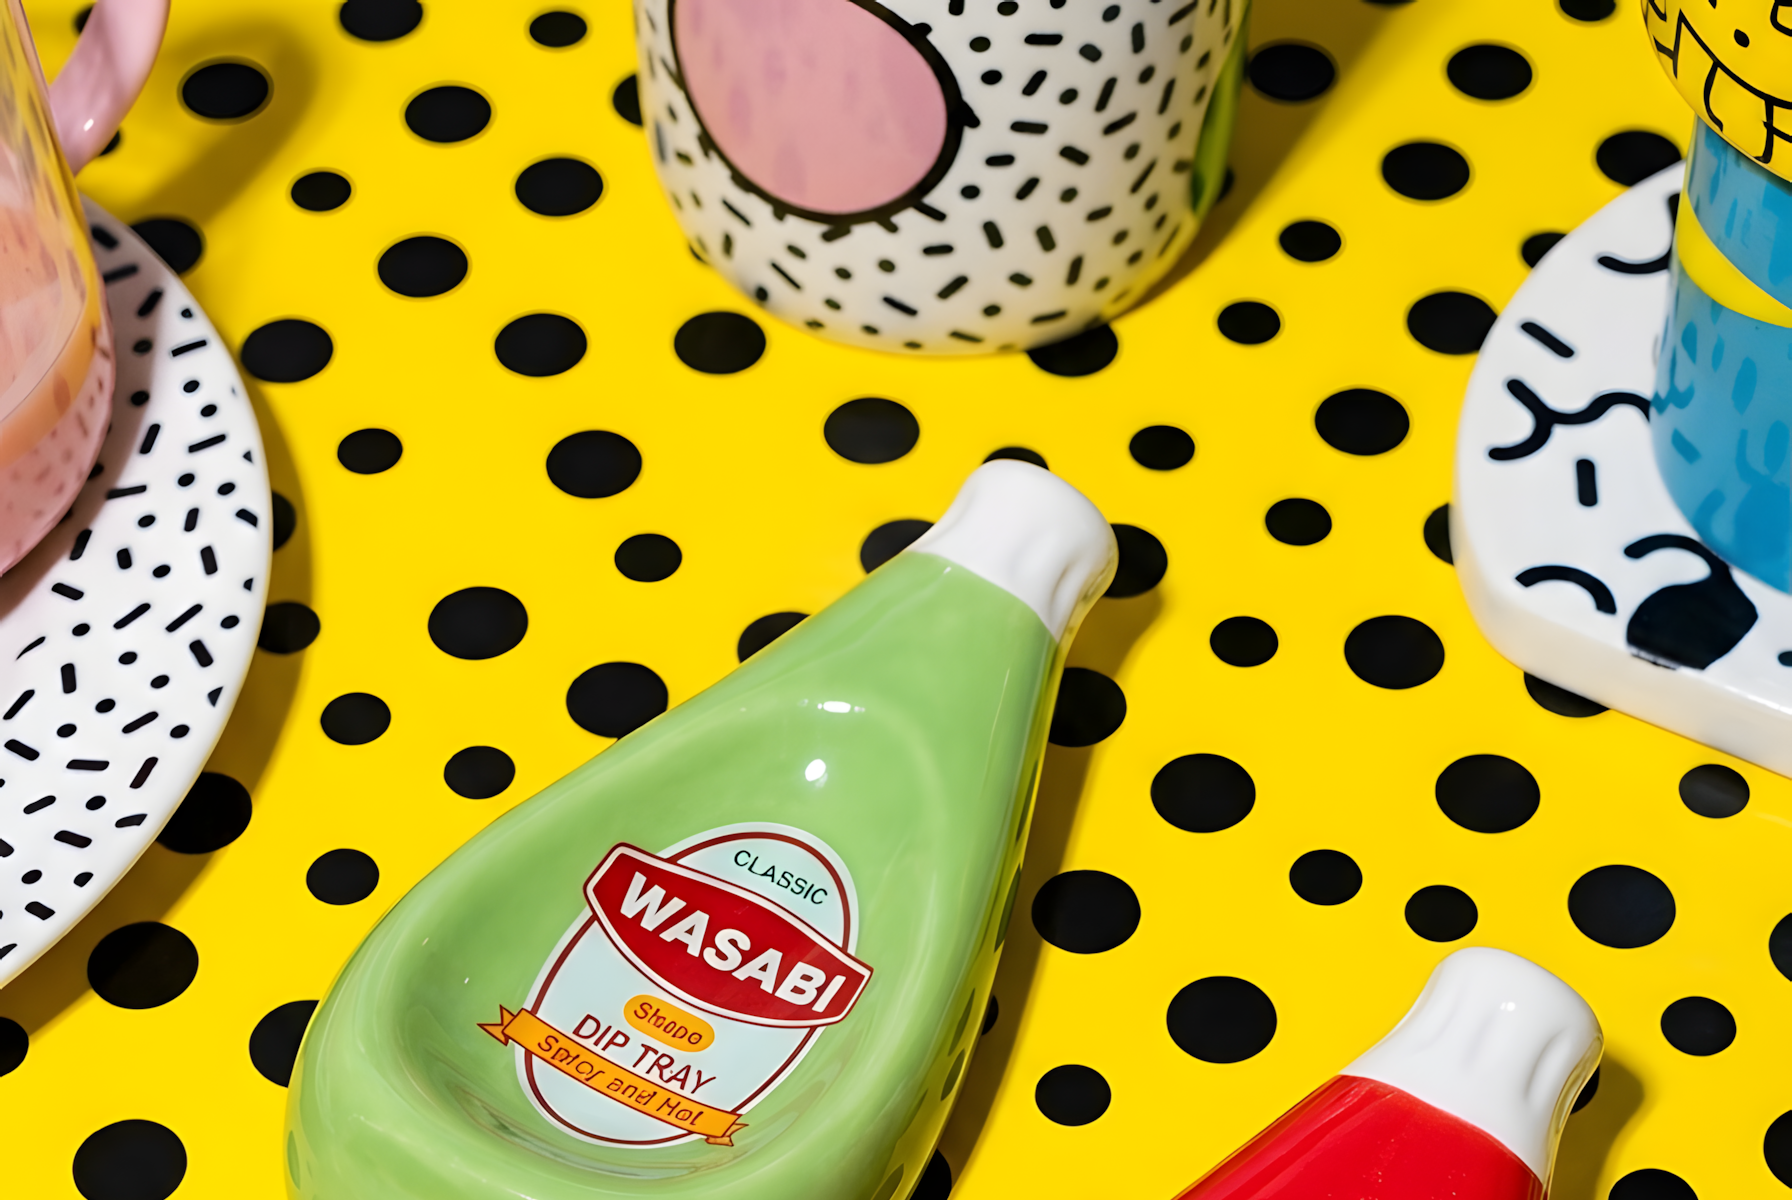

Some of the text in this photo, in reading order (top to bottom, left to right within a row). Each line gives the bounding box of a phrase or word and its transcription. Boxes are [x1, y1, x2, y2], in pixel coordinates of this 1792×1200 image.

[733, 849, 829, 906] CLASSIC
[619, 870, 848, 1014] WASABI
[572, 1013, 717, 1095] DIP TRAY
